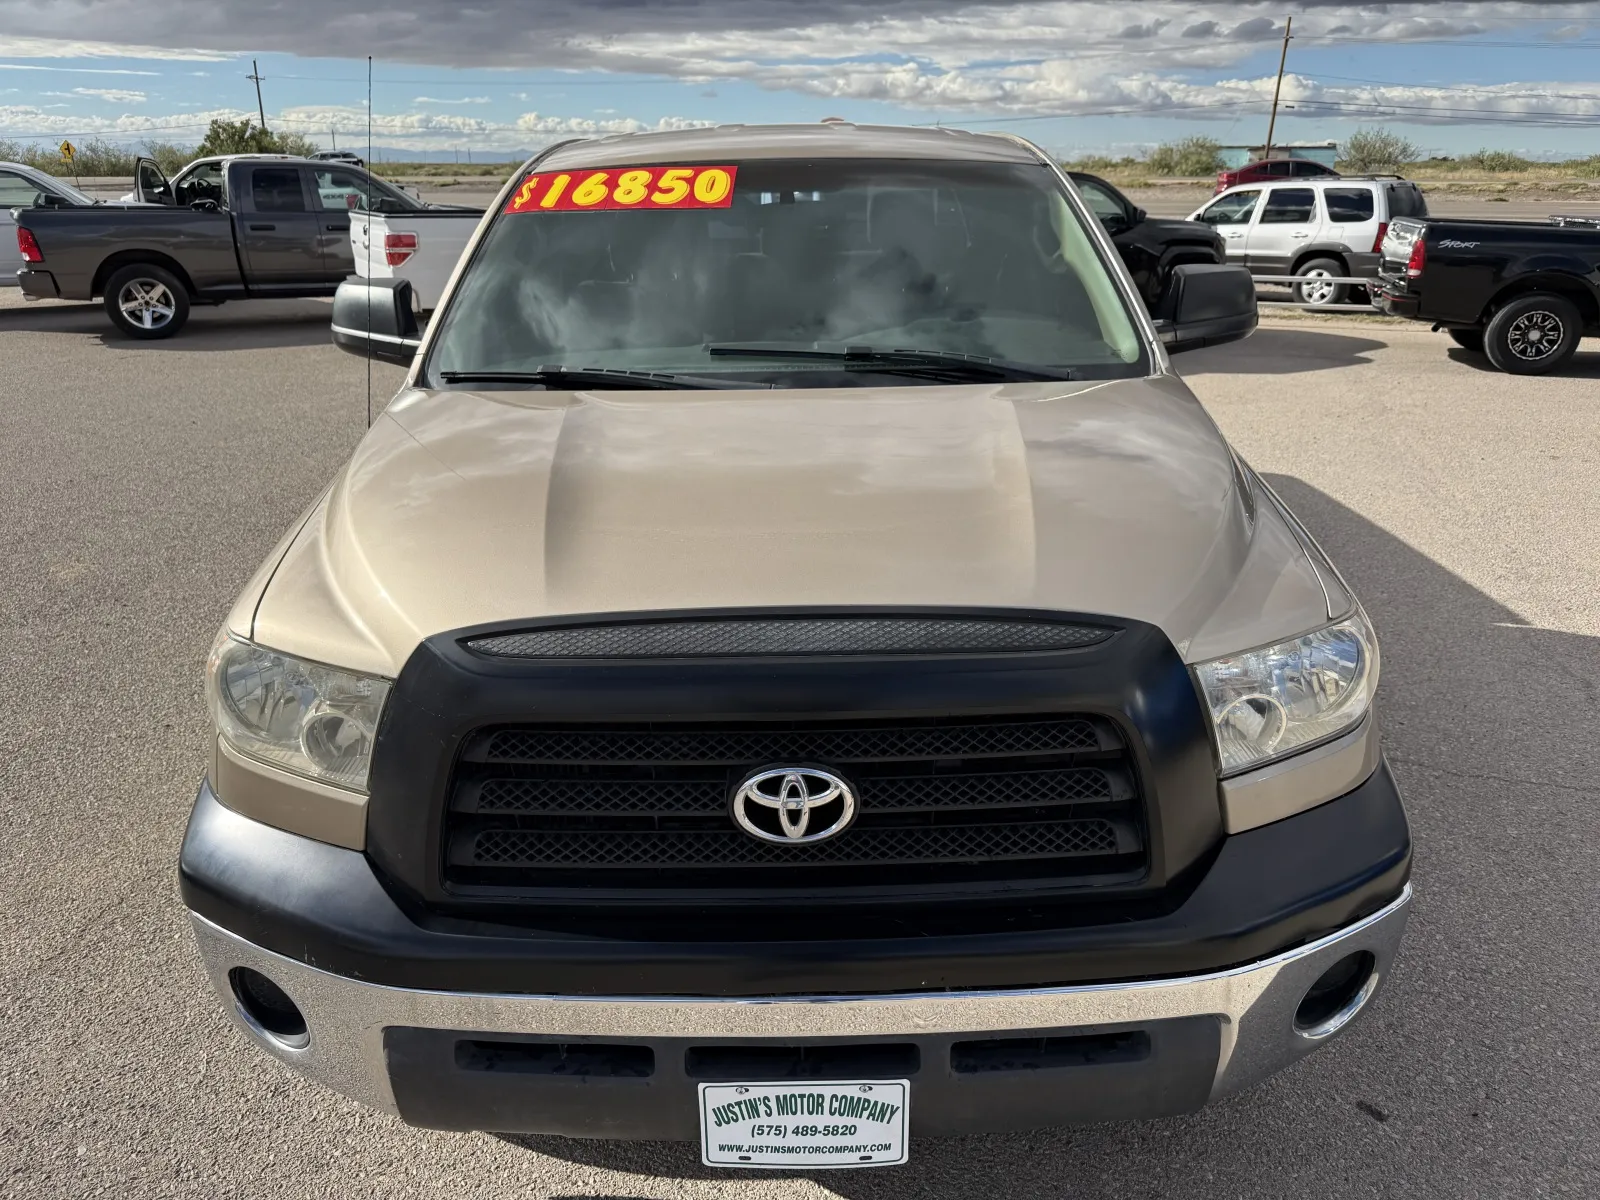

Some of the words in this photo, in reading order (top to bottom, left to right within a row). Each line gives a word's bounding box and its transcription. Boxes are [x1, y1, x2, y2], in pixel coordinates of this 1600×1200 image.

[712, 1095, 773, 1127] JUSTIN'S
[775, 1093, 825, 1116] MOTOR
[829, 1093, 900, 1125] COMPANY
[751, 1124, 788, 1138] (575)
[792, 1124, 857, 1137] 489-5820
[718, 1142, 892, 1154] WWW.JUSTINSMOTORCOMPANY.COM
